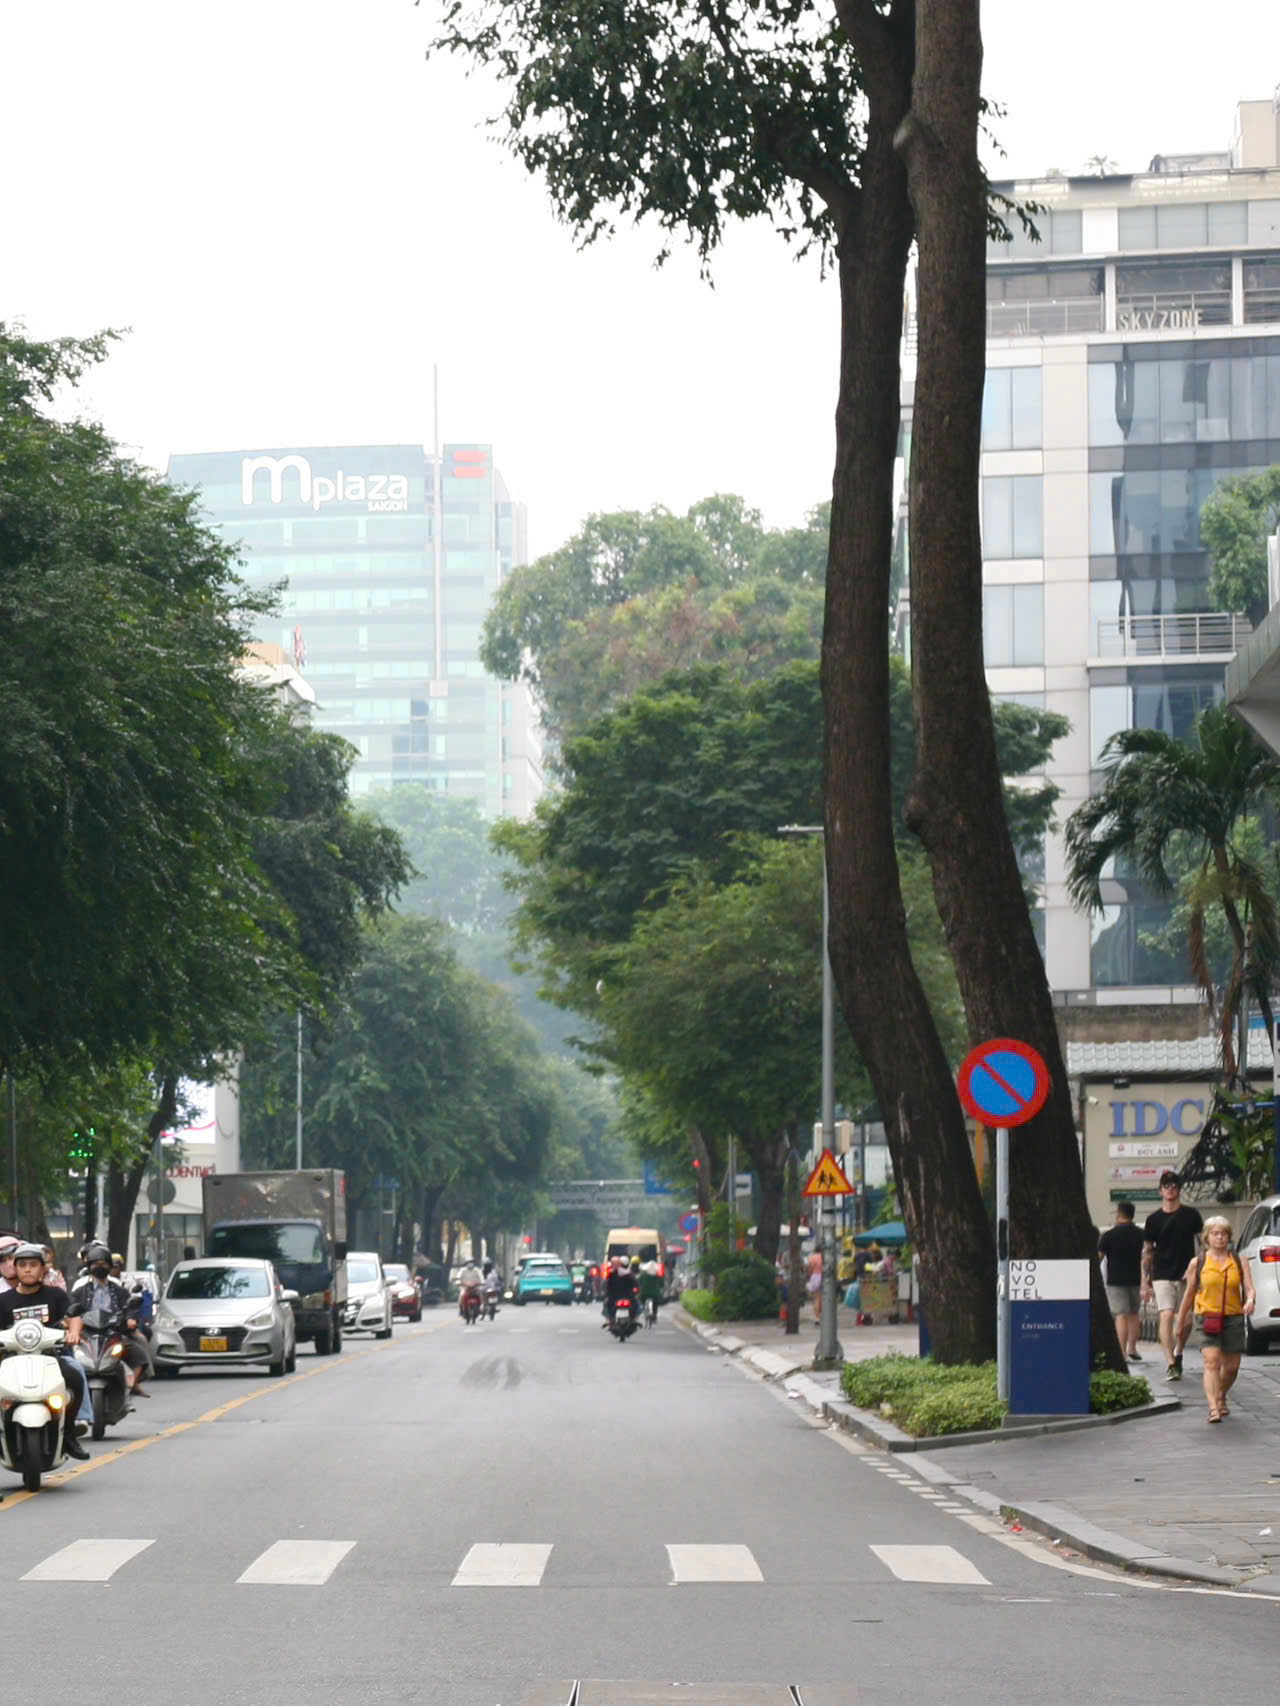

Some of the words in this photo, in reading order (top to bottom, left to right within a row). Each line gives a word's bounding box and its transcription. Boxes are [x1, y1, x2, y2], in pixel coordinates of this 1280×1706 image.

[367, 501, 408, 512] SAIGON
[1109, 1098, 1205, 1138] IDC
[1011, 1288, 1042, 1300] TEL
[1021, 1322, 1063, 1330] ENTRANCE
